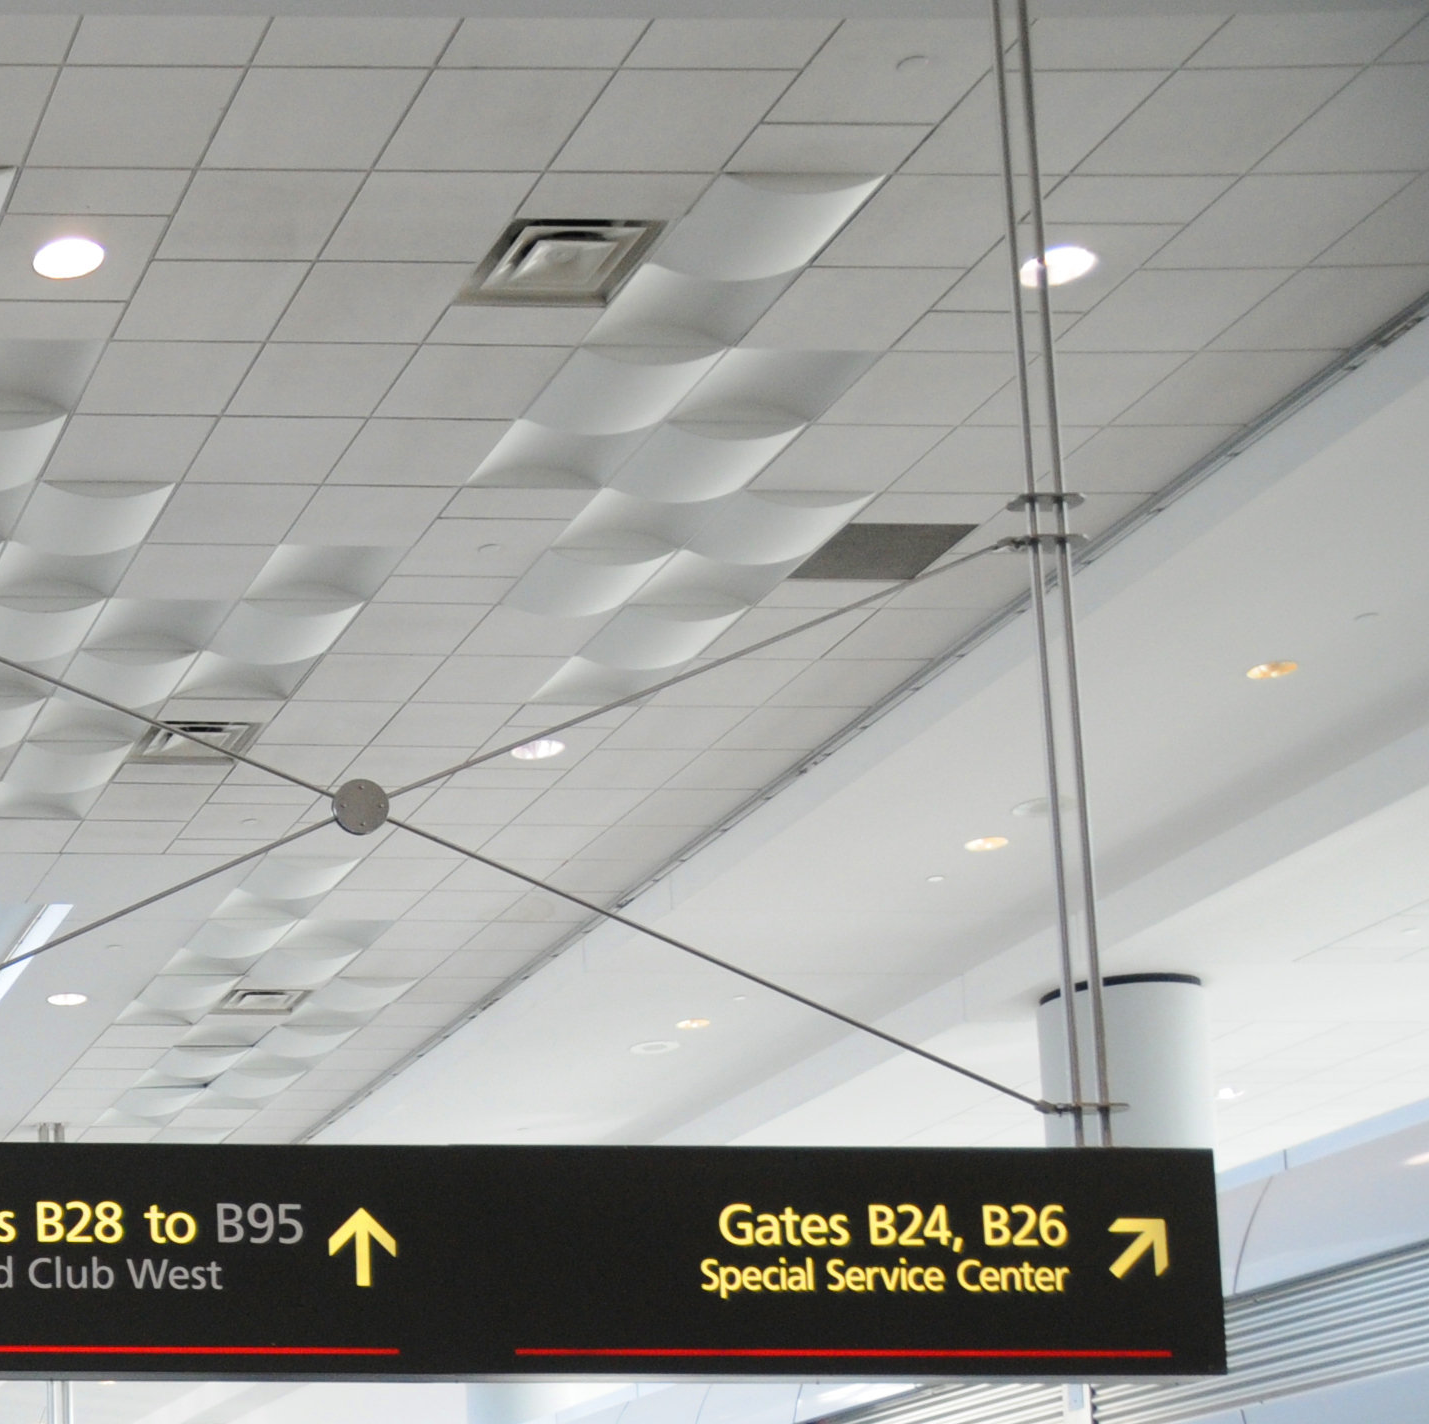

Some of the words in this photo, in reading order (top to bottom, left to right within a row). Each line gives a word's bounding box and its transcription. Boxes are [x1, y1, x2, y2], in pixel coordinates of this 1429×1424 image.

[36, 1201, 124, 1243] B28
[144, 1205, 197, 1244] to
[217, 1203, 303, 1244] B95
[719, 1203, 850, 1246] Gates
[868, 1204, 963, 1252] B24,
[982, 1204, 1068, 1247] B26
[29, 1256, 114, 1289] Club
[127, 1259, 222, 1289] West
[701, 1257, 815, 1299] Special
[826, 1257, 946, 1292] Service
[957, 1259, 1069, 1292] Center
